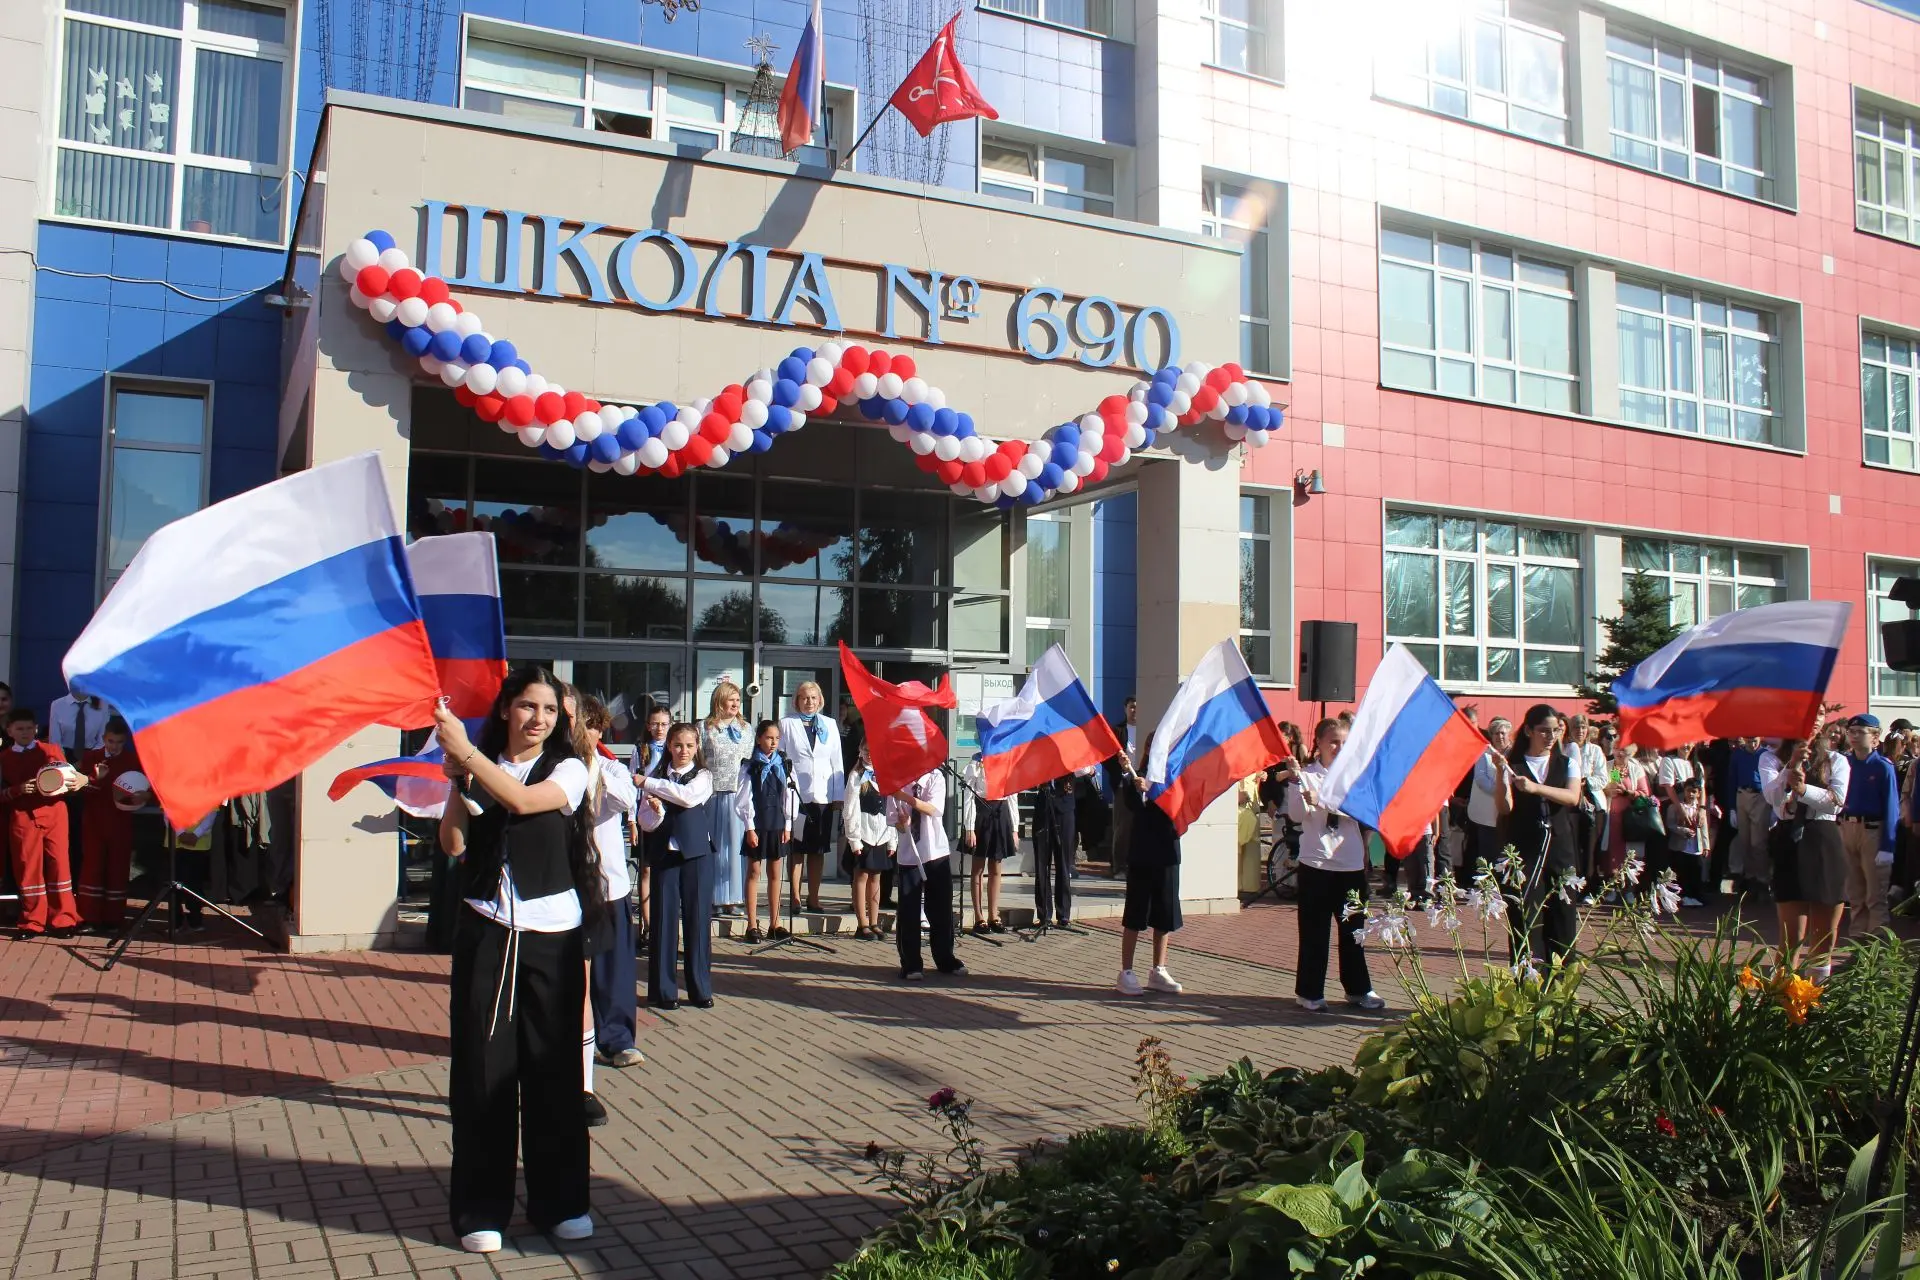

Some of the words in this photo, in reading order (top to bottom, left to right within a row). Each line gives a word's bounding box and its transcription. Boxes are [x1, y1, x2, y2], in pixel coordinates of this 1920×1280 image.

[422, 200, 844, 332] ШКОЛА
[880, 263, 981, 345] №
[1016, 287, 1181, 376] 690
[984, 679, 1013, 688] ВЫХОД
